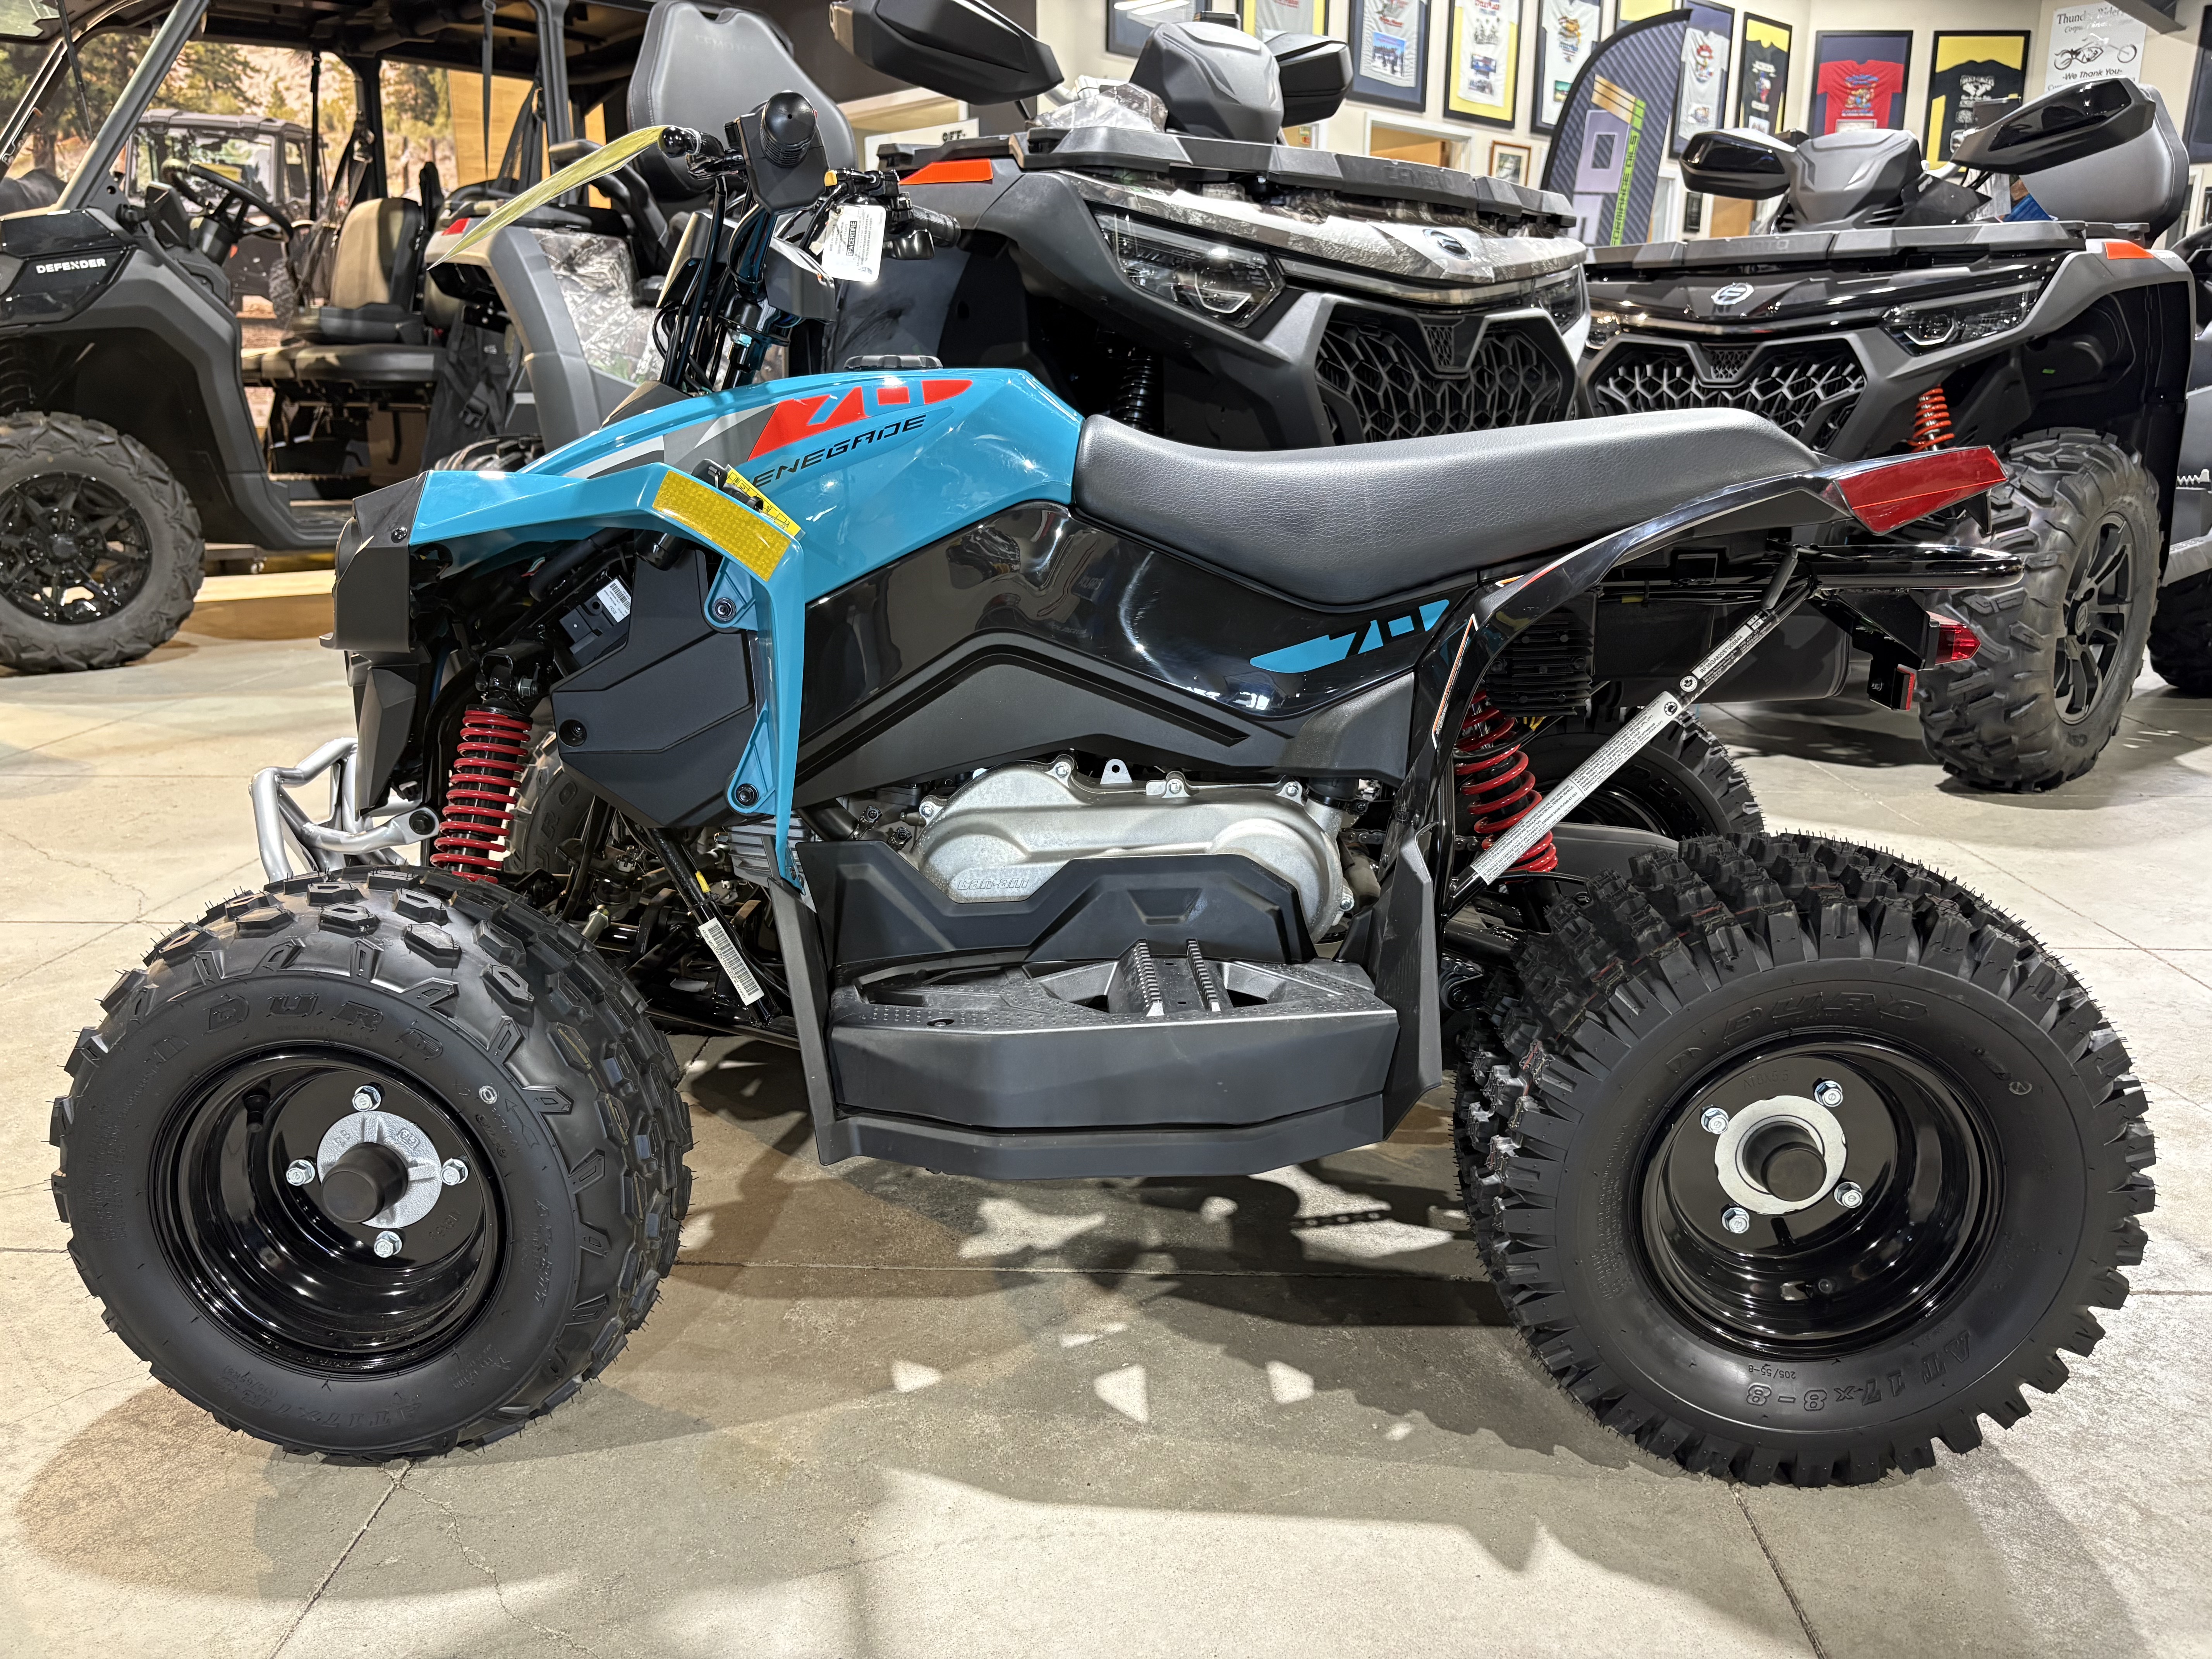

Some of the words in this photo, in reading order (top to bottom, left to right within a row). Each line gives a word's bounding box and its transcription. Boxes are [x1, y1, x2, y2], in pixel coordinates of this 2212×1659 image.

[2080, 69, 2103, 78] Thank
[1625, 136, 1638, 167] OILS
[36, 258, 106, 274] DEFENDER
[747, 414, 927, 489] ENEGADE
[608, 605, 617, 615] ECU
[1493, 840, 1507, 853] CERTIFIED
[1537, 801, 1551, 814] GASOLINE
[1498, 839, 1513, 853] CALIFORNIA
[1512, 827, 1527, 841] EMISSIONS
[1525, 812, 1543, 829] REGULATIONS
[957, 878, 1029, 891] can-am
[735, 984, 747, 999] TAIWAN
[204, 993, 443, 1061] DURO
[1747, 1364, 1796, 1379] 205/55-8
